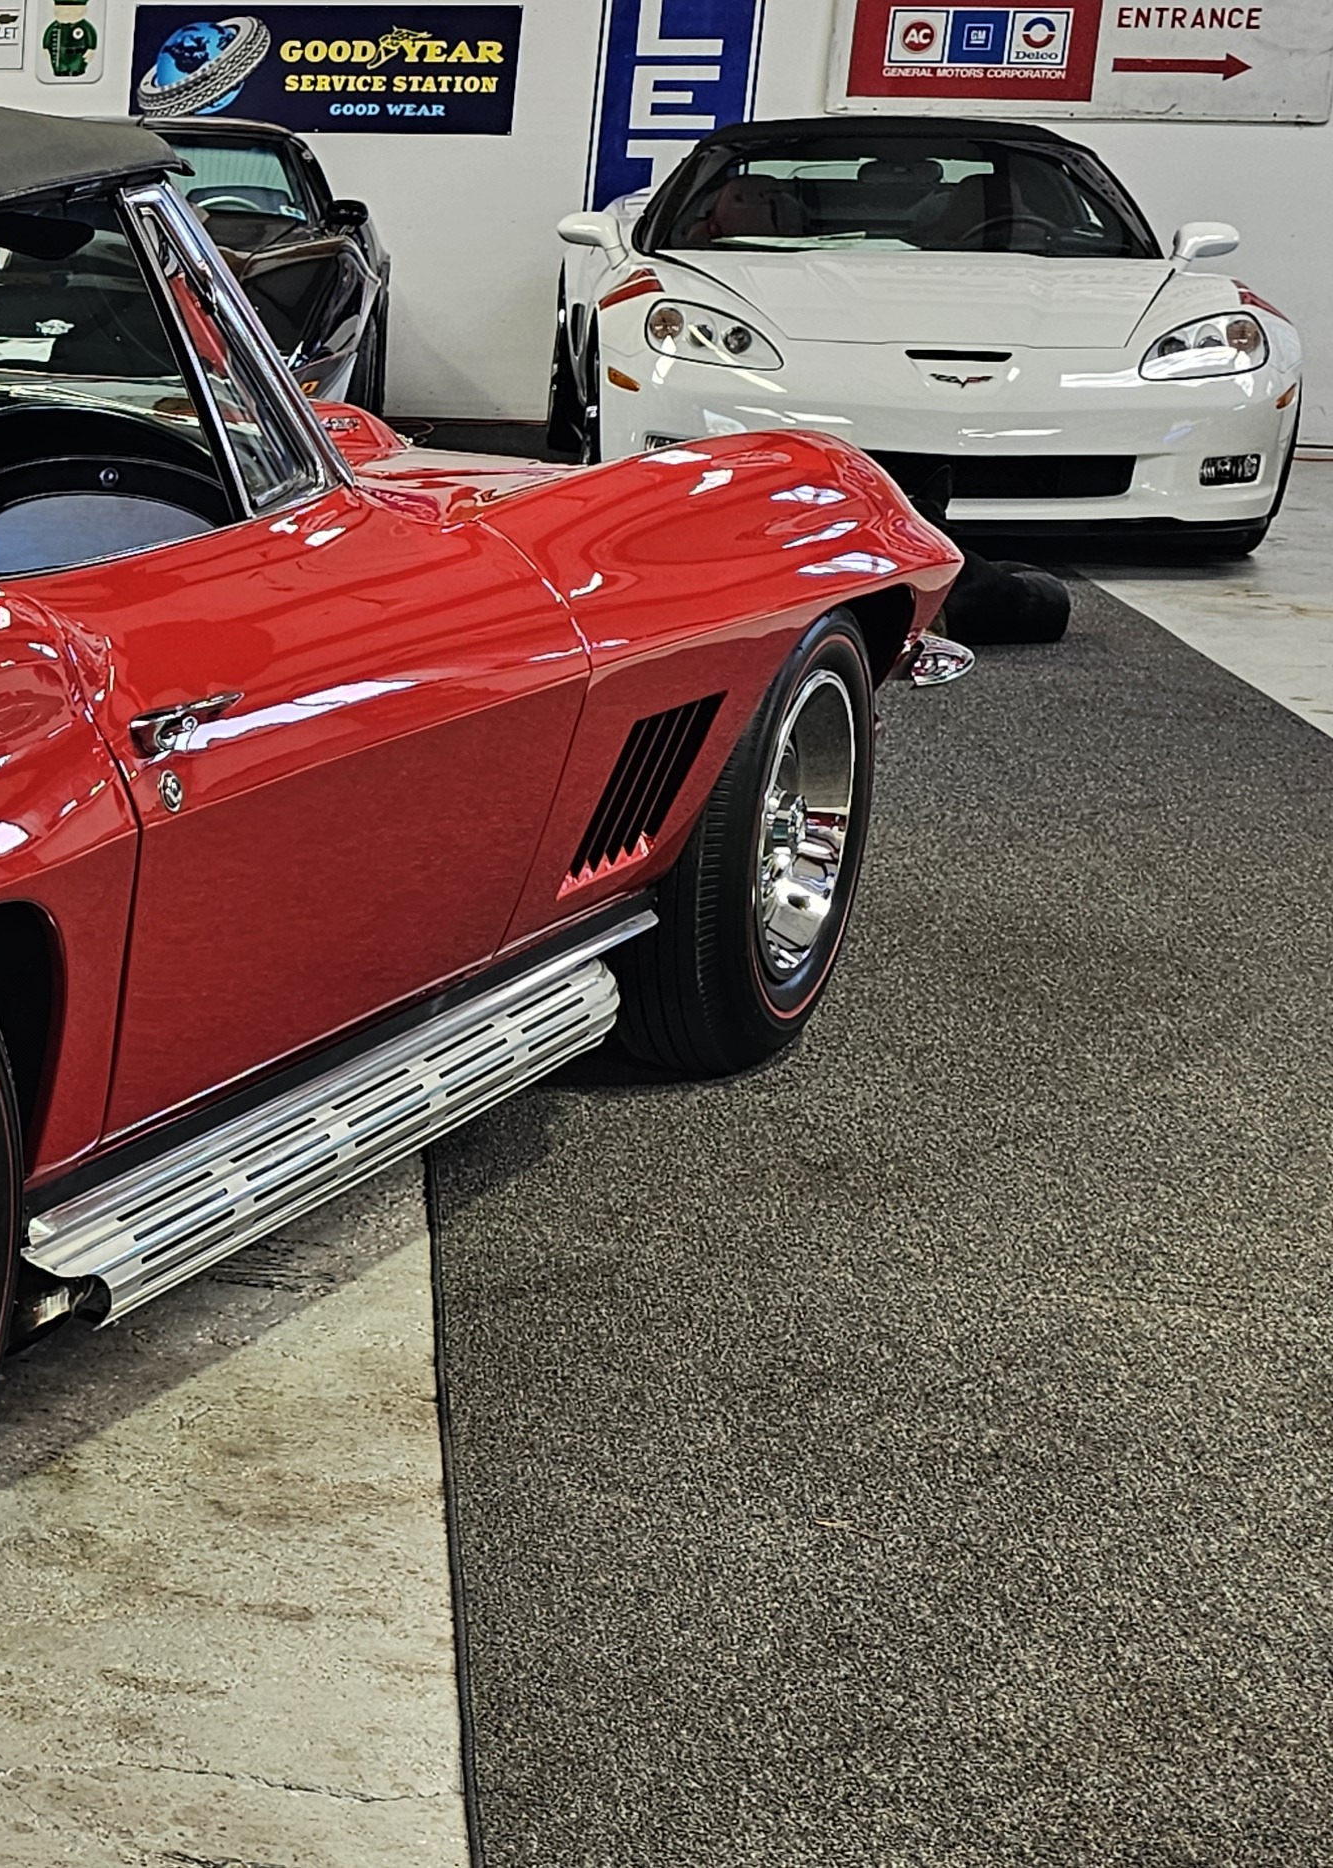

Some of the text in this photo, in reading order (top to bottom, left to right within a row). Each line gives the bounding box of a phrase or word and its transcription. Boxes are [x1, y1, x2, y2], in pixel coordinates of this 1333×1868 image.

[1117, 7, 1263, 29] ENTRANCE
[904, 28, 931, 45] AC
[970, 30, 986, 42] GM
[1014, 50, 1059, 60] Delco
[882, 67, 1066, 79] GENERAL MOTORS CORPORATION
[284, 75, 499, 93] SERVICE STATION
[329, 103, 446, 117] GOOD WEAR
